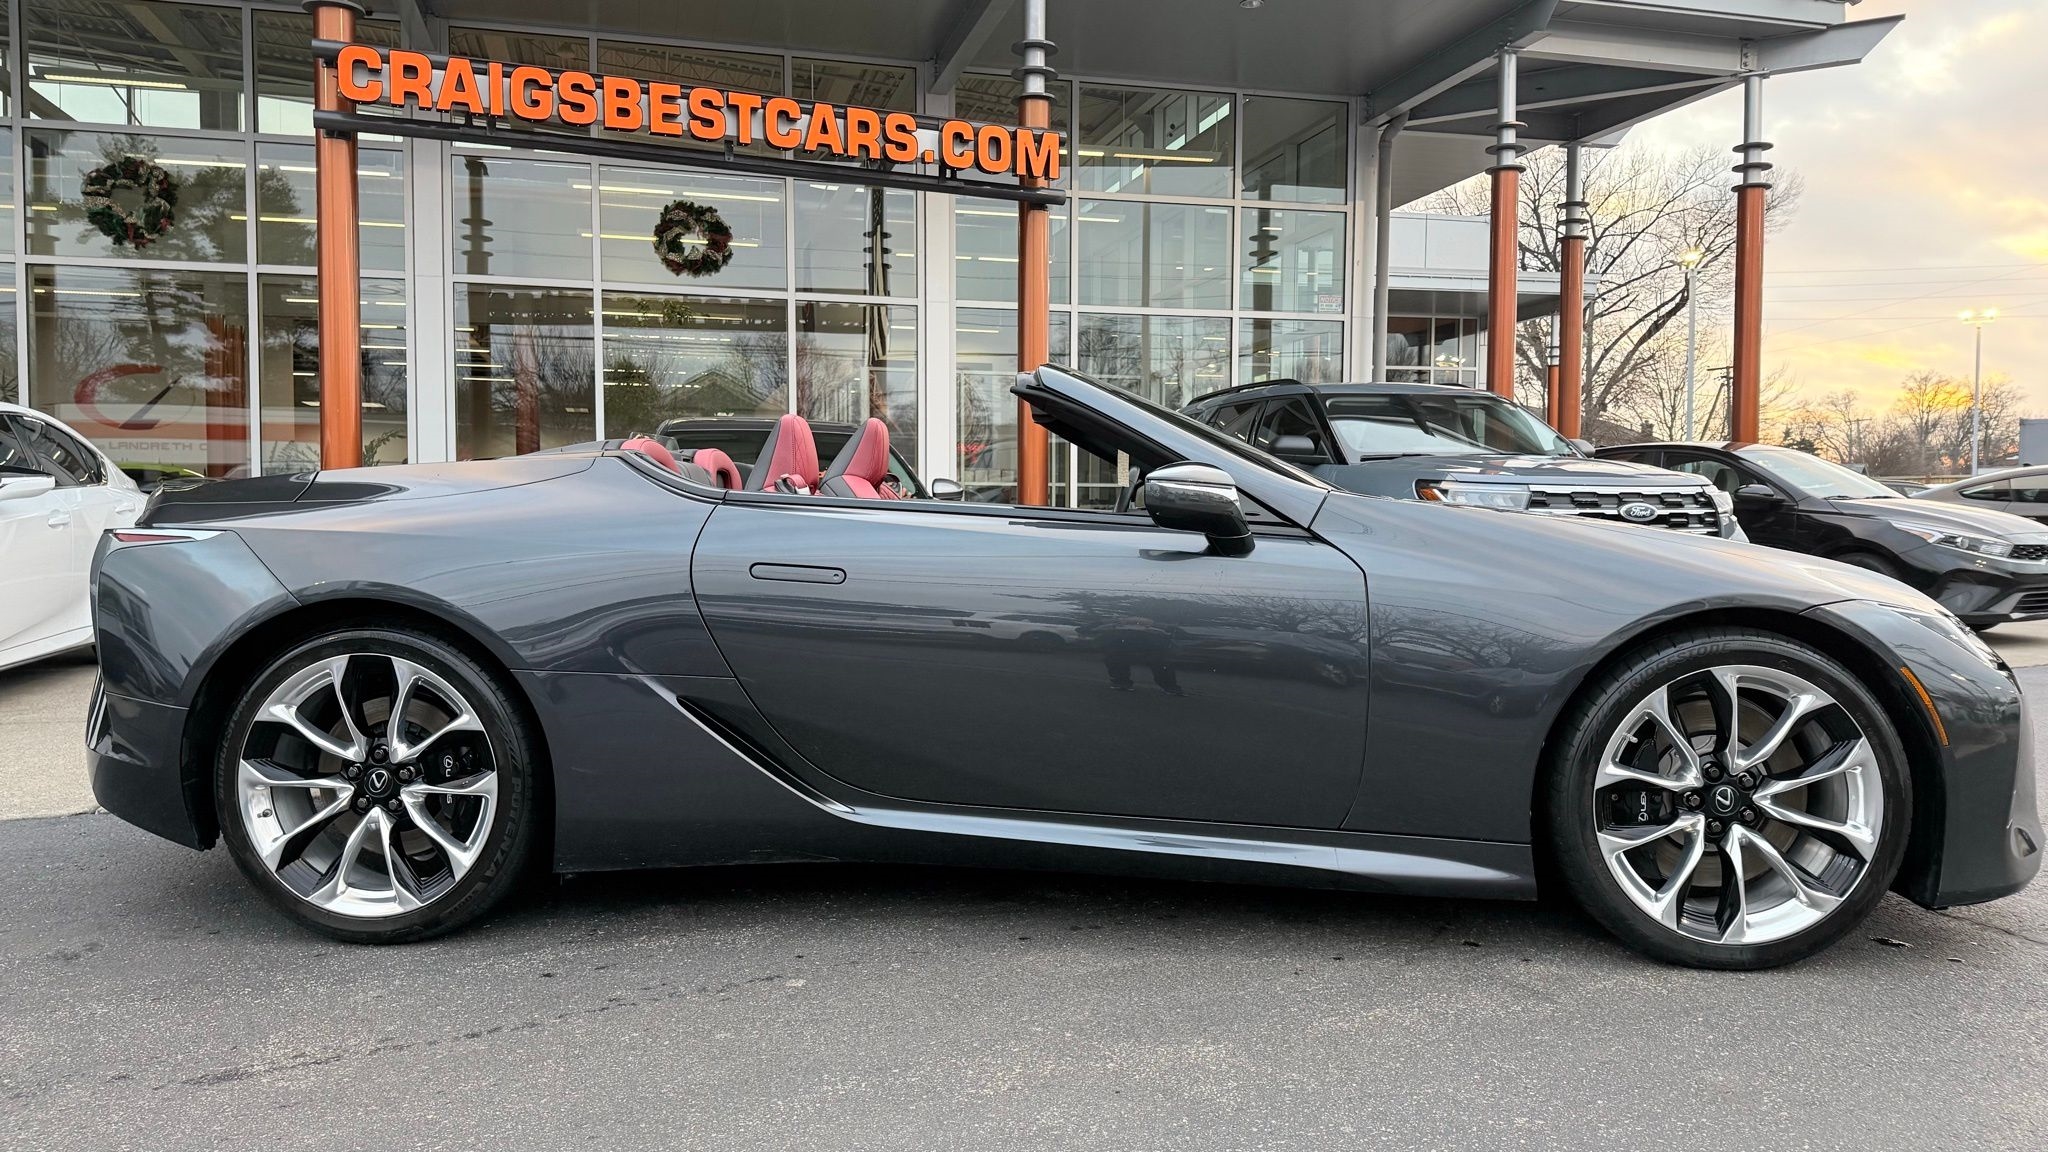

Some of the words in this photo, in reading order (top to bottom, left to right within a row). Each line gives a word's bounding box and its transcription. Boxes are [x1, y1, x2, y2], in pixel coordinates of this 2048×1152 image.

[337, 44, 1060, 180] CRAIGSBESTCARS.COM
[108, 440, 193, 451] LANDRETH
[1630, 506, 1651, 517] Ford
